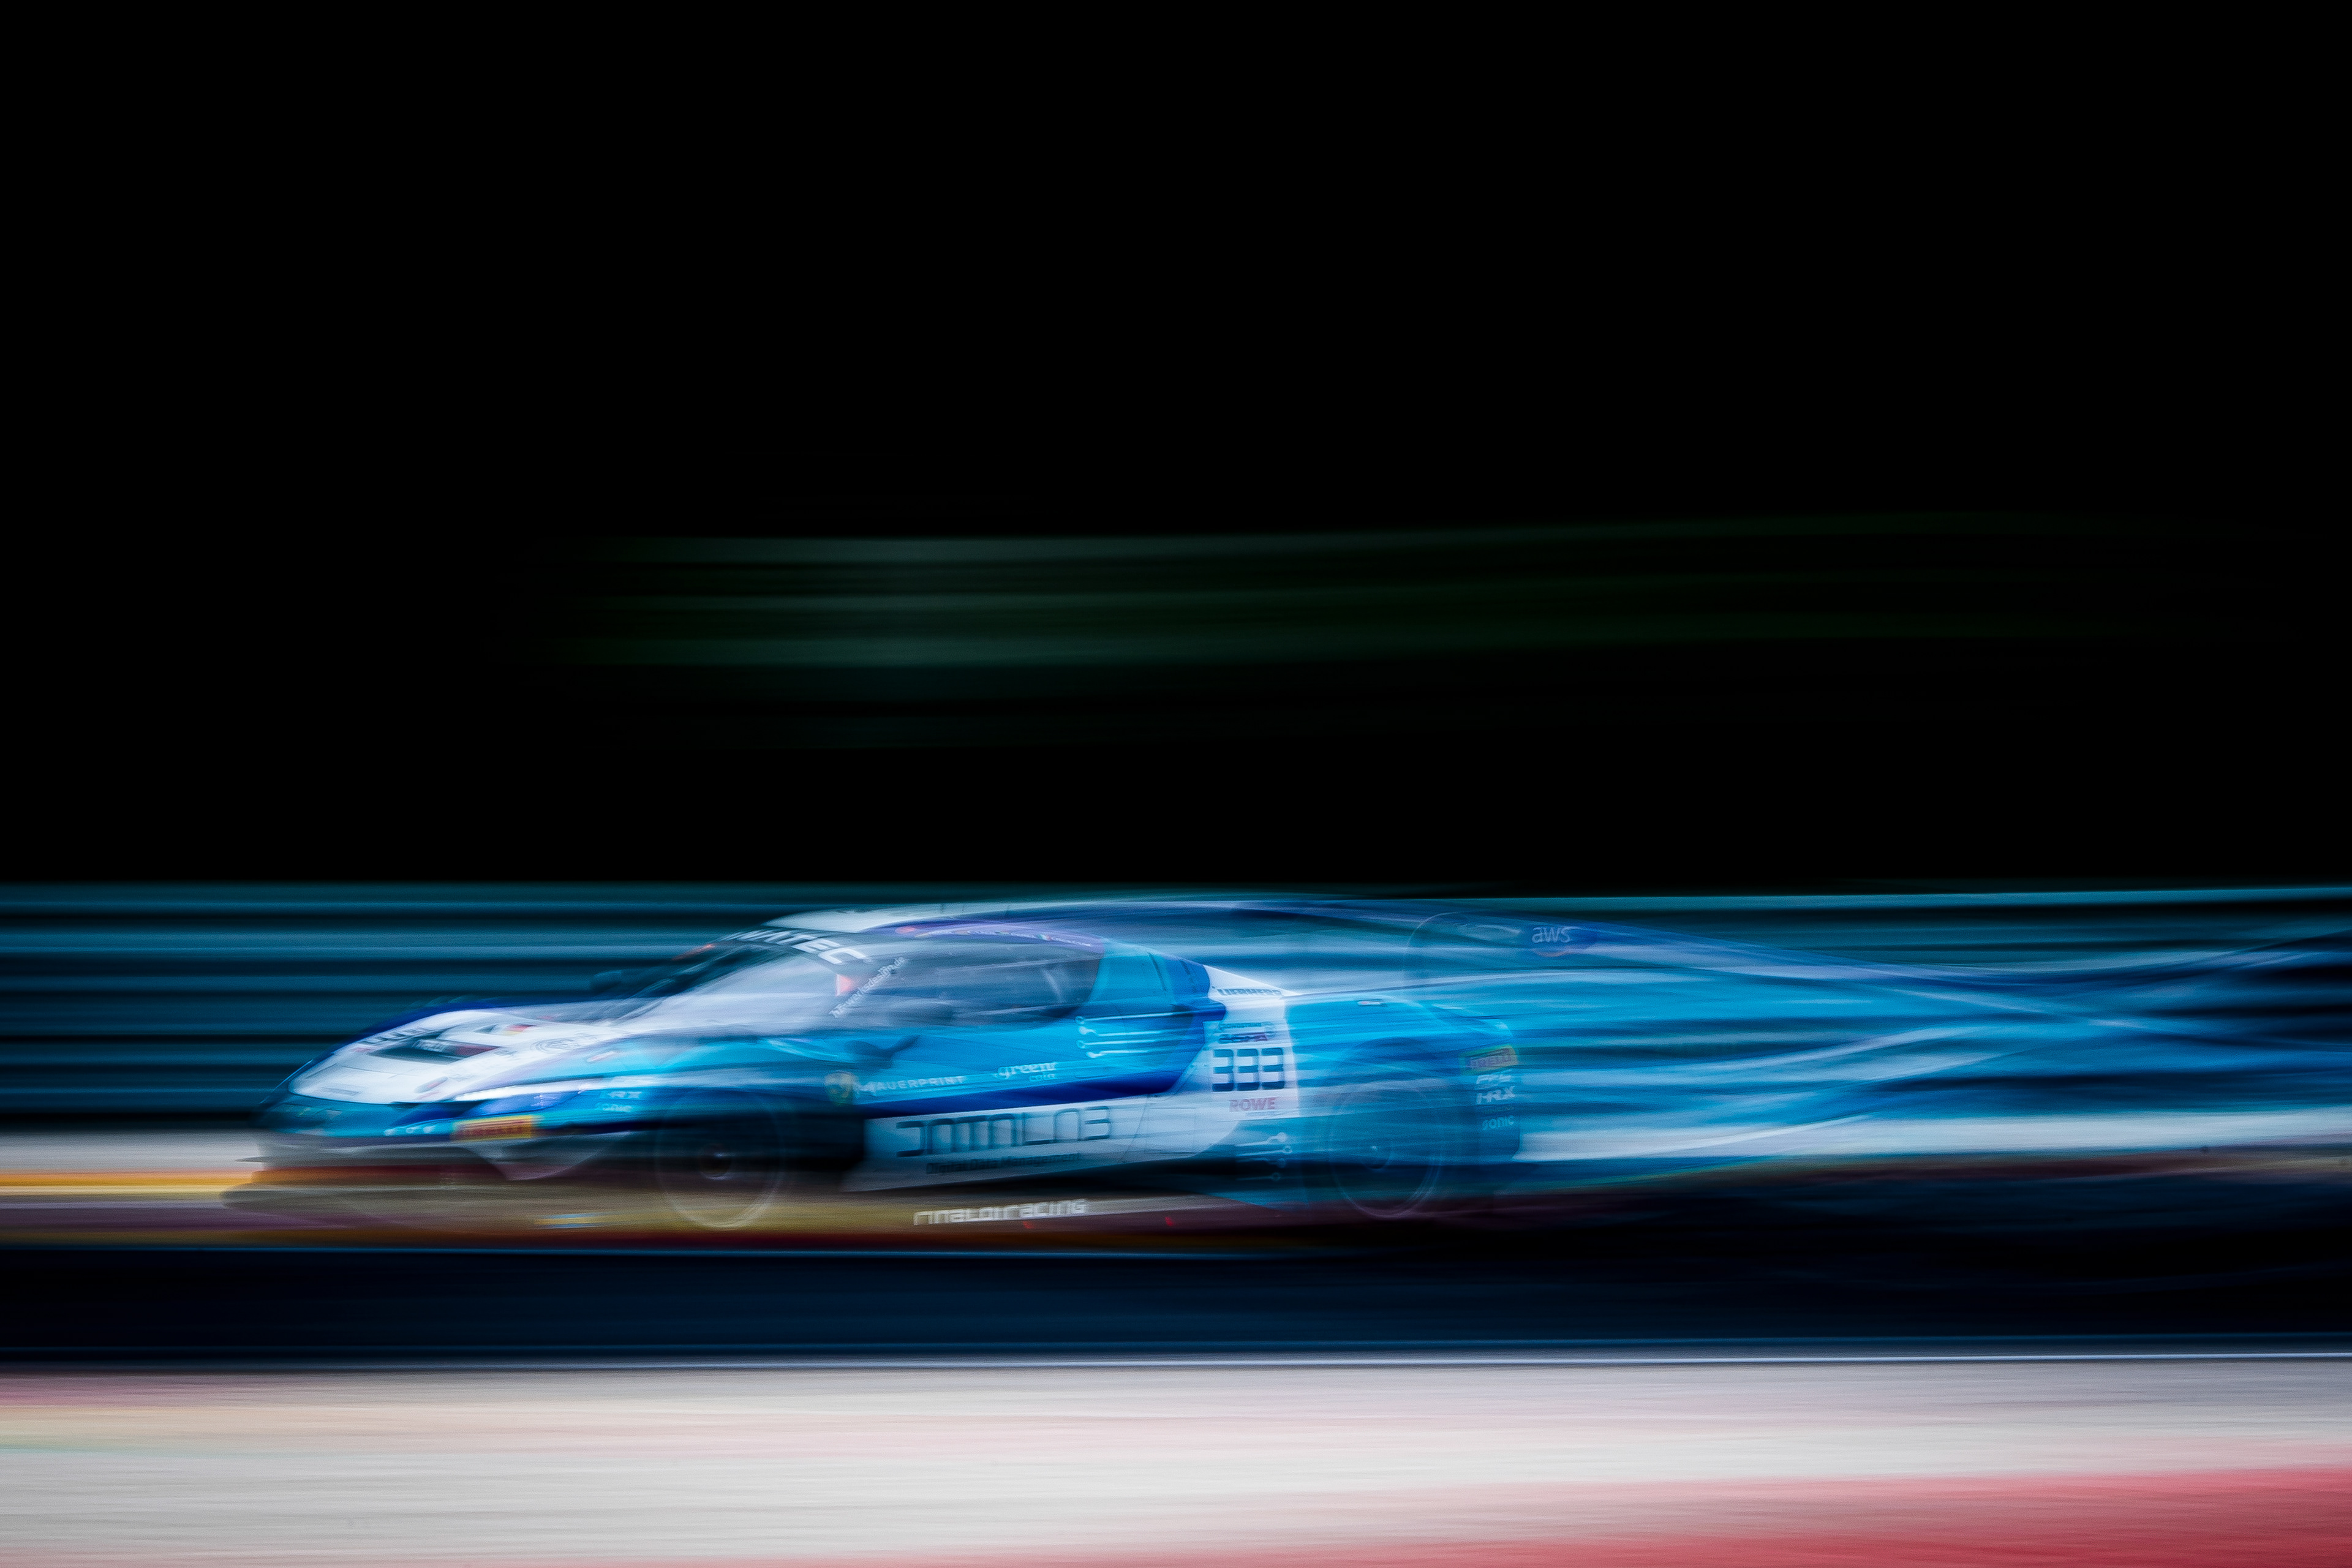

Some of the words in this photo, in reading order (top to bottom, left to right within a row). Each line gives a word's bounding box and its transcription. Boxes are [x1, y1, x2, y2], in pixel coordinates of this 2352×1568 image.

[1532, 926, 1572, 943] aws
[1212, 1047, 1284, 1092] 333
[1229, 1097, 1277, 1112] ROWE
